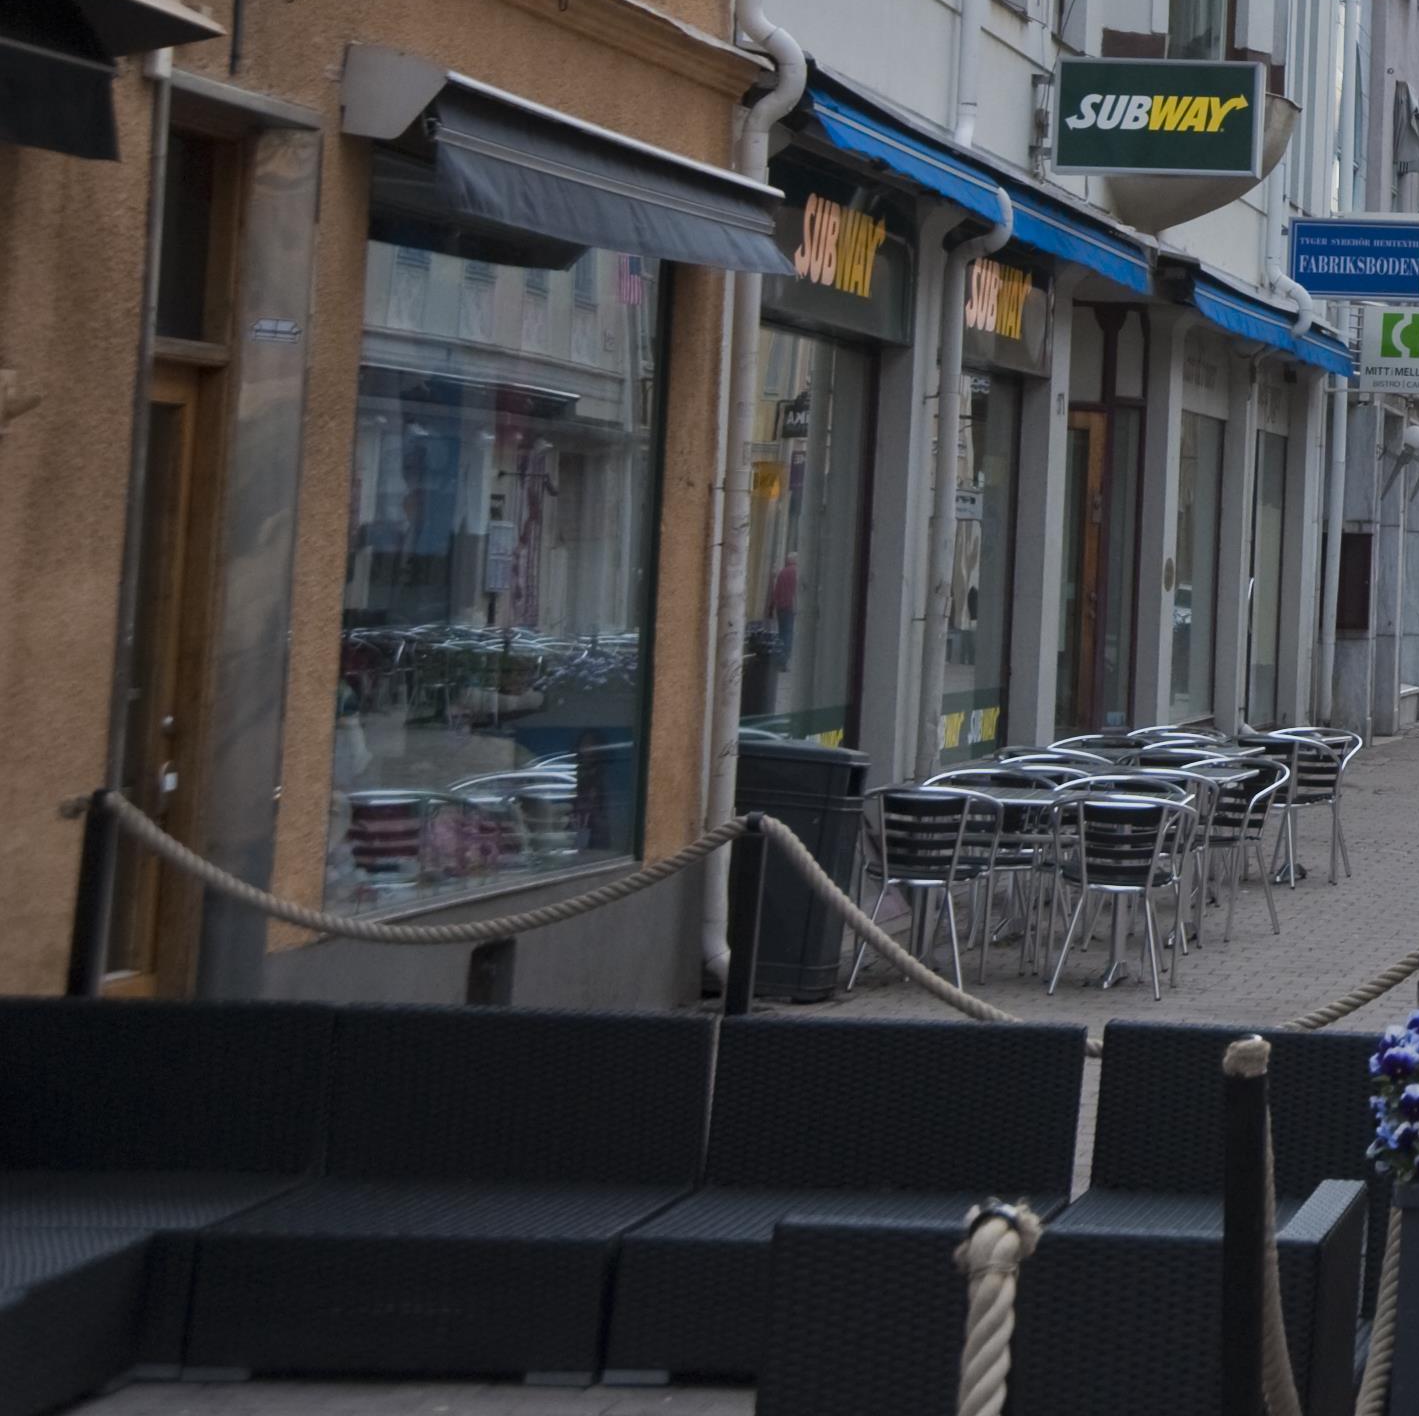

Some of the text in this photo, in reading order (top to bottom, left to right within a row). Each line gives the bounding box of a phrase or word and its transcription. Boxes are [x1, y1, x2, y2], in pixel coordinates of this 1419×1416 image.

[1064, 93, 1249, 133] SUBWAY
[794, 192, 888, 299] SUBWAY
[1299, 254, 1419, 277] FABRIKSBODEN
[965, 257, 1033, 341] SUBWAY
[1364, 366, 1390, 377] MITT
